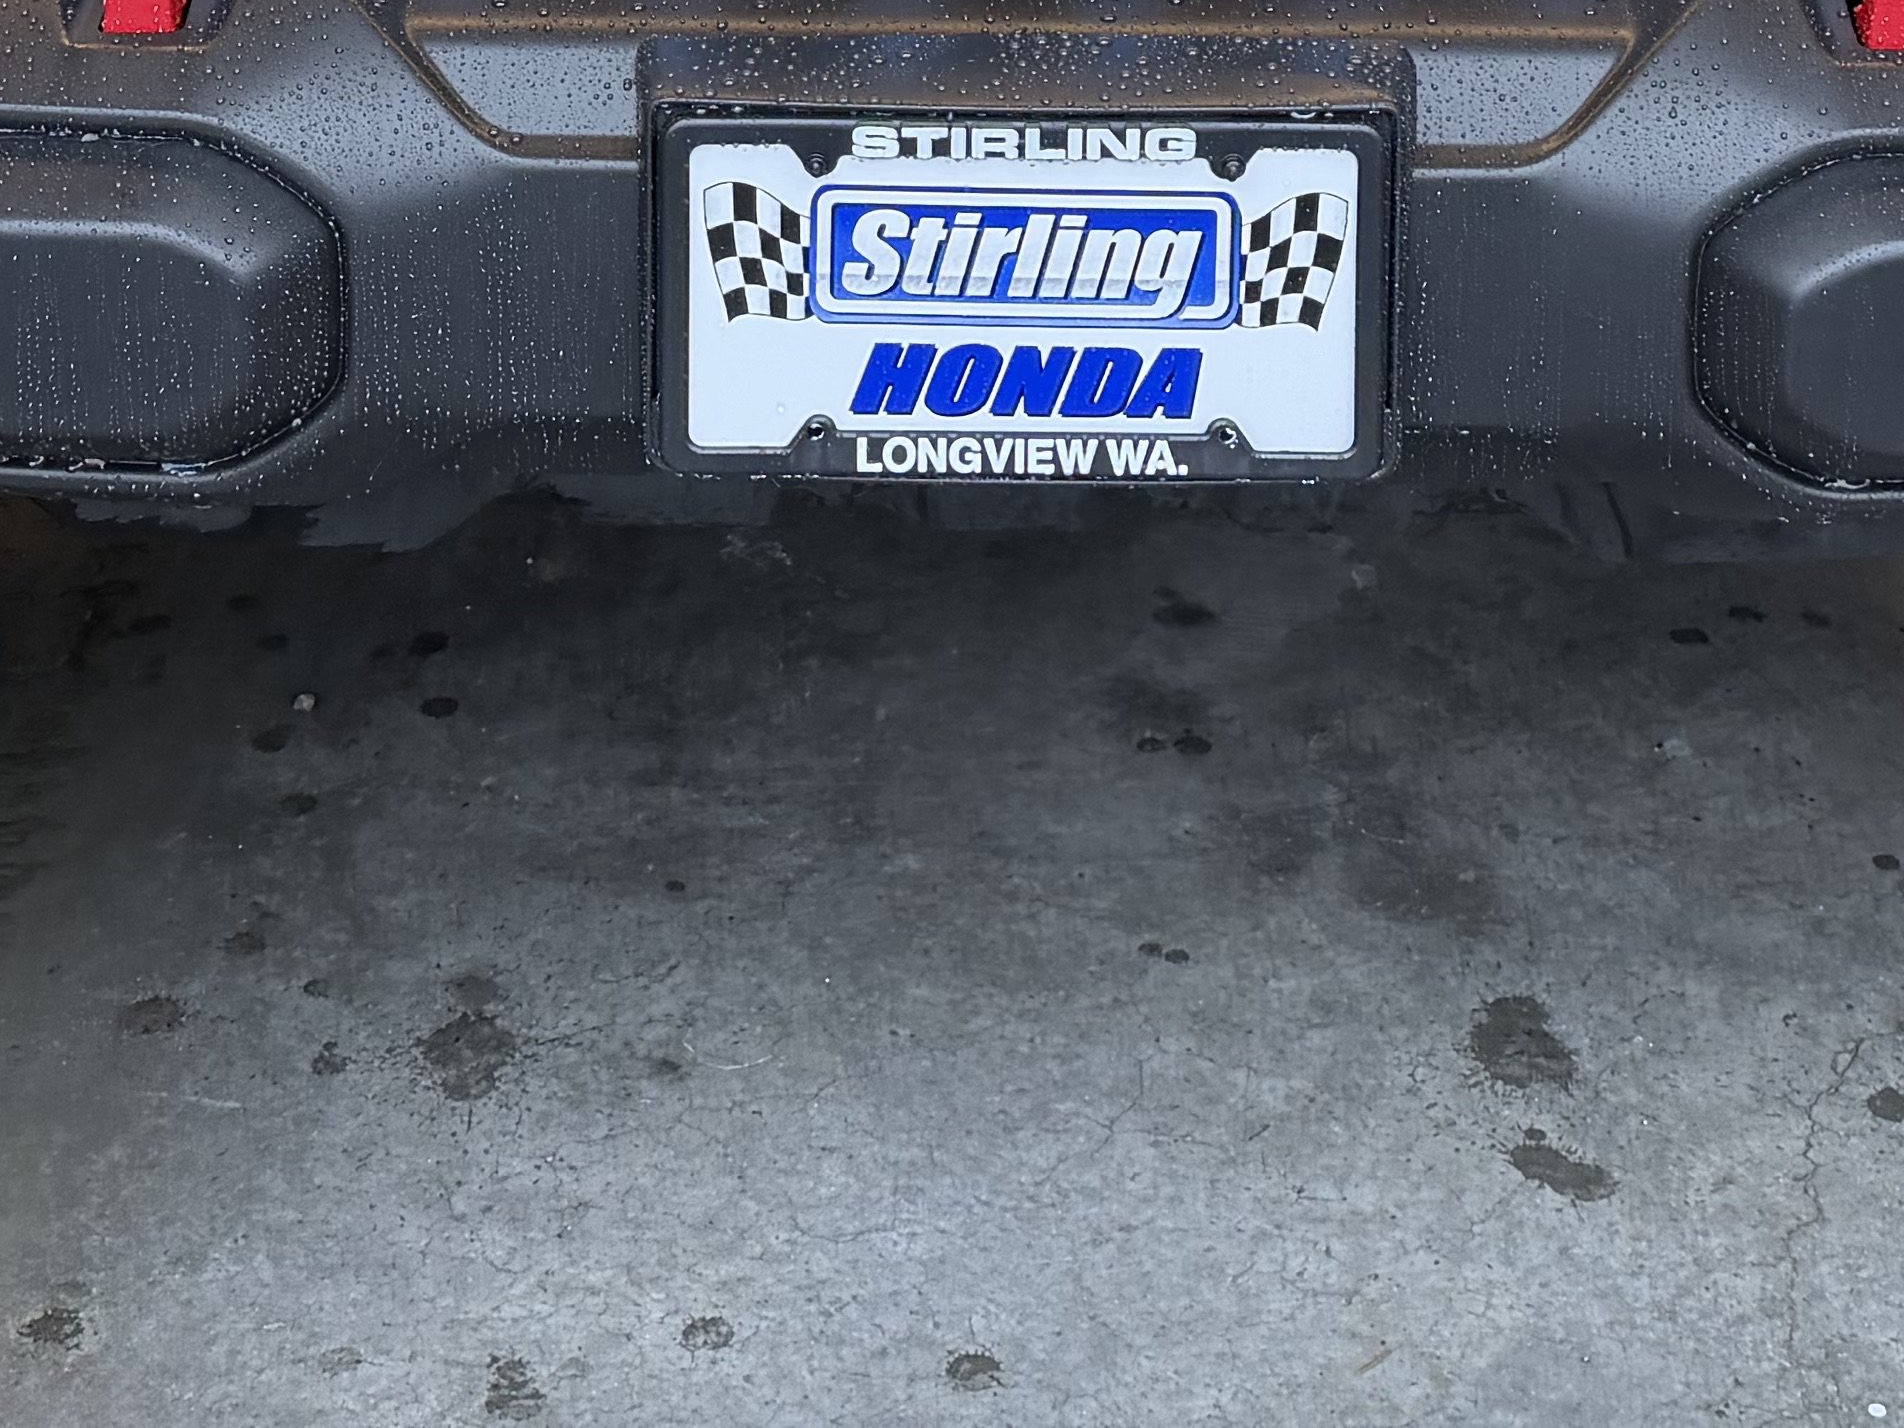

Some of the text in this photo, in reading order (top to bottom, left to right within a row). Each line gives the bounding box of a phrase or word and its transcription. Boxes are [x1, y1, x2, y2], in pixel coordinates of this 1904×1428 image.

[851, 125, 1197, 162] STIRLING
[841, 208, 1206, 318] Stirling
[849, 342, 1203, 419] HONDA
[856, 437, 1188, 476] LONGVIEW WA.
